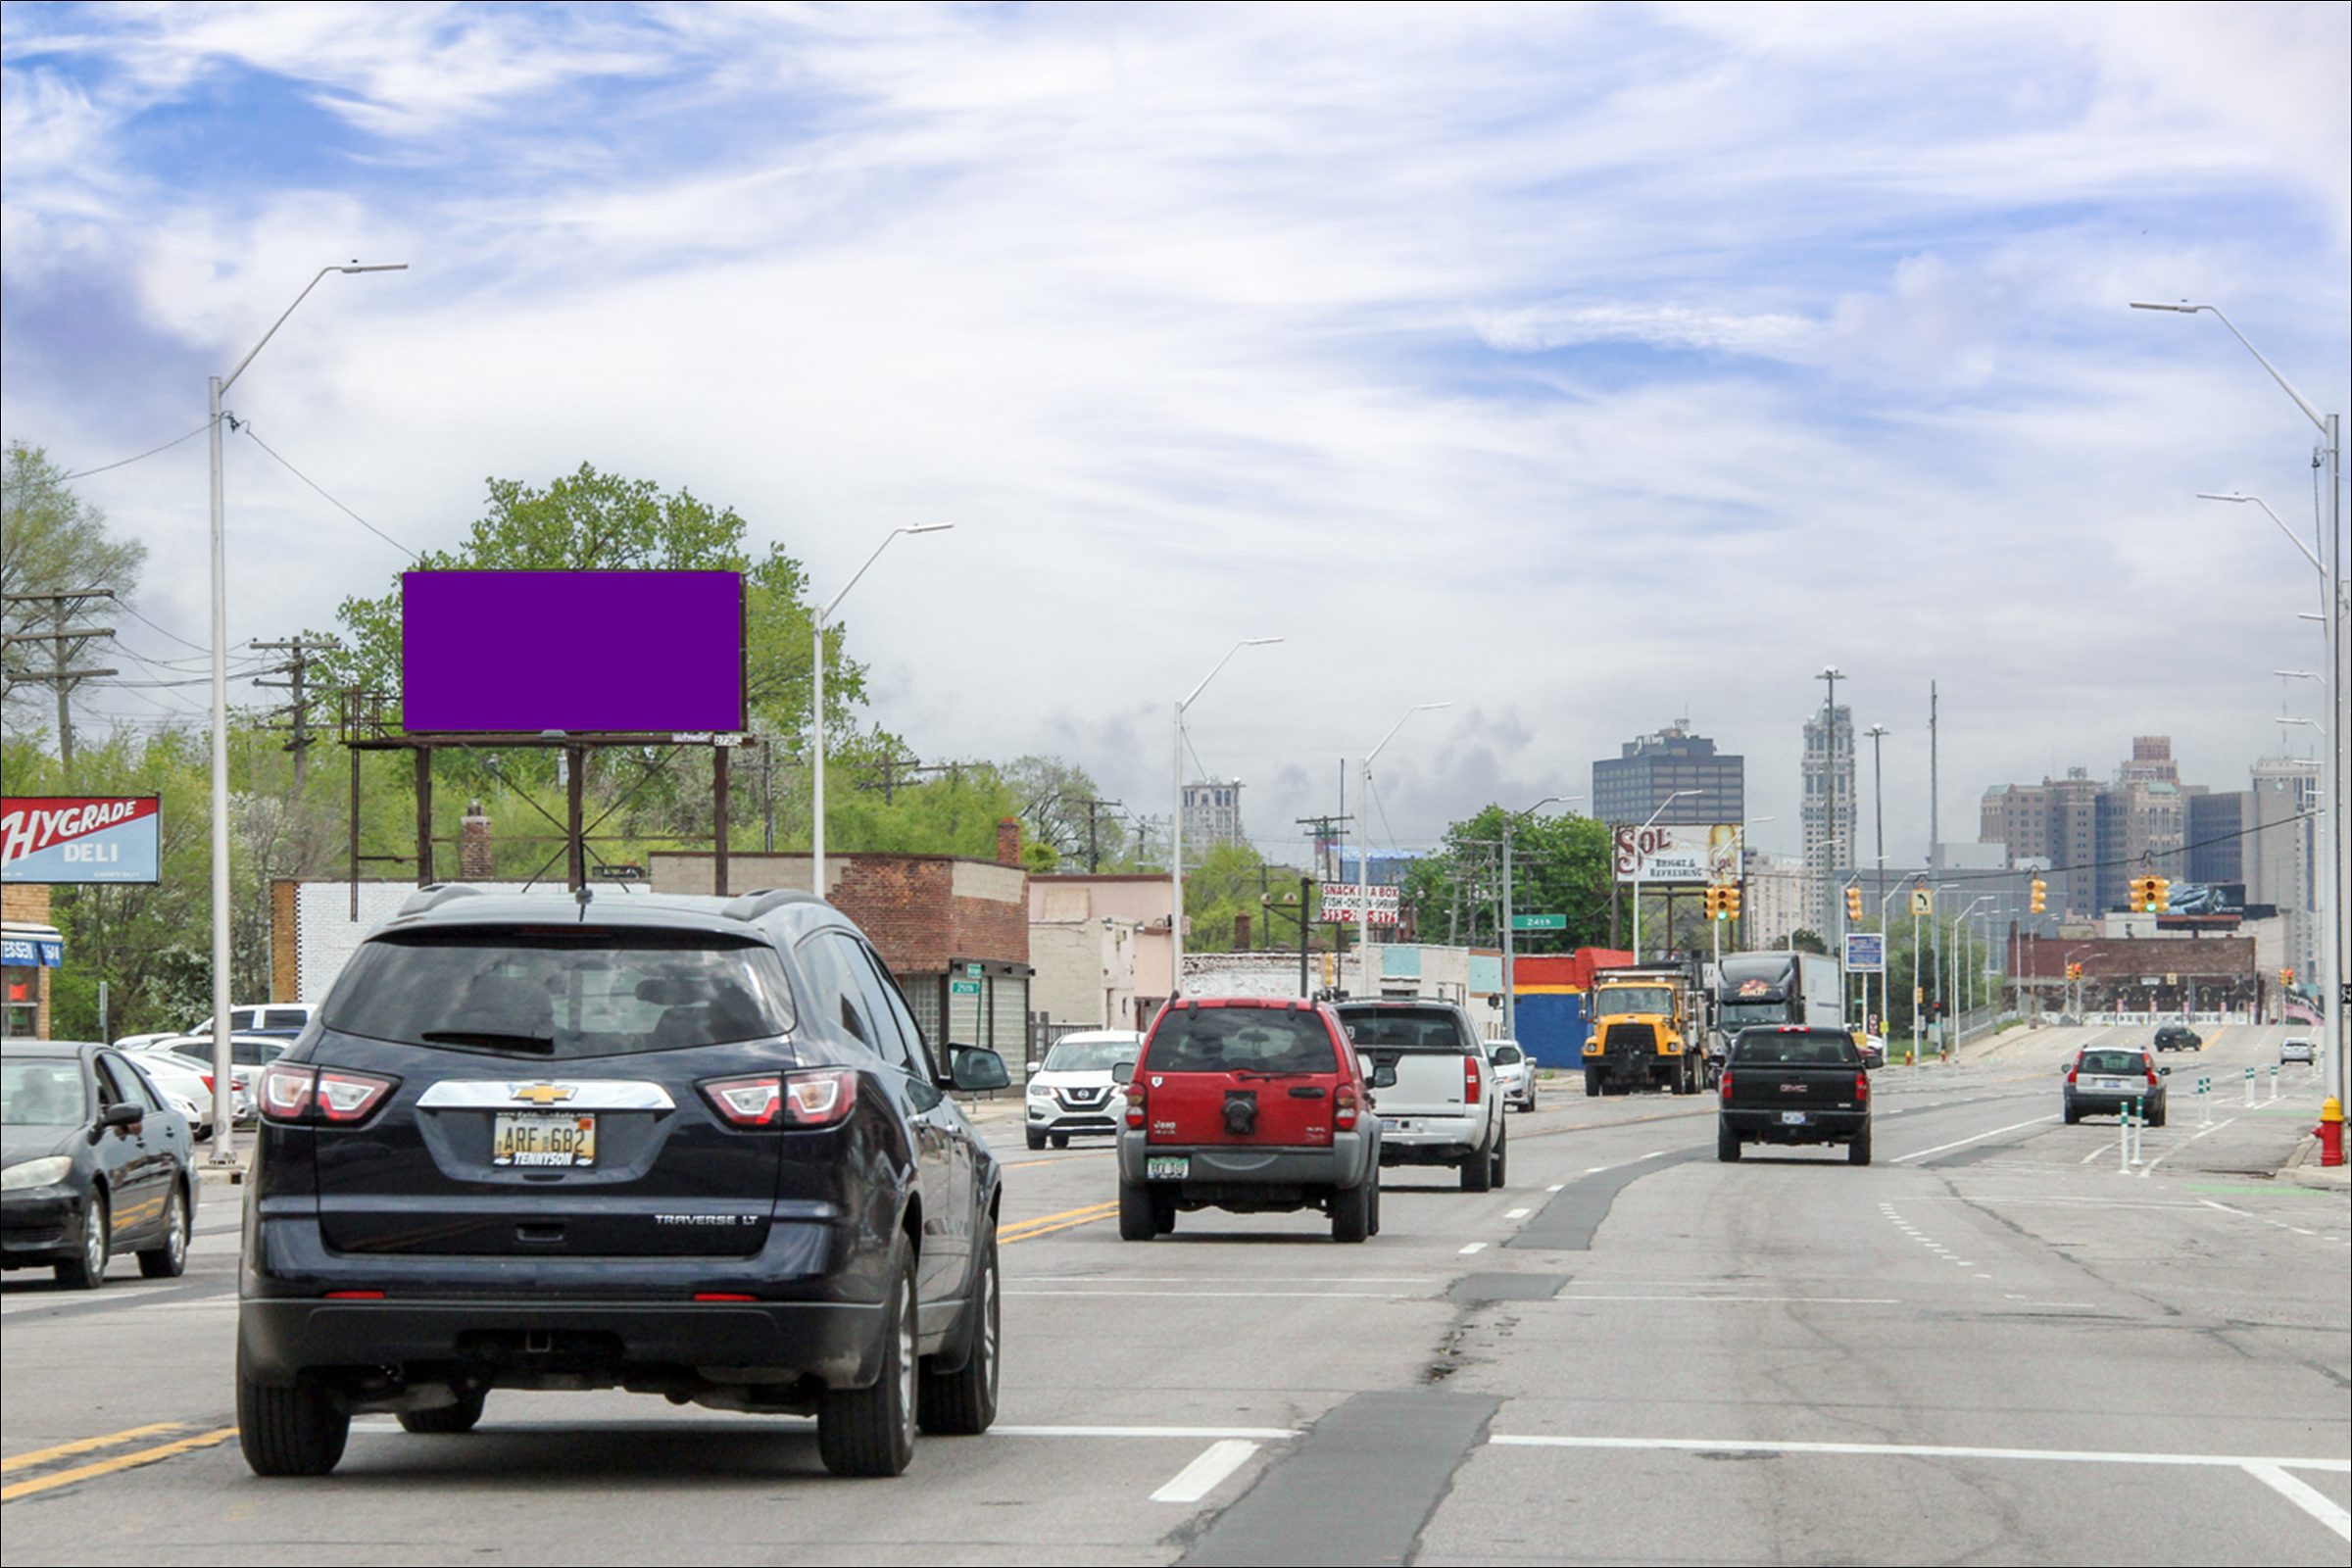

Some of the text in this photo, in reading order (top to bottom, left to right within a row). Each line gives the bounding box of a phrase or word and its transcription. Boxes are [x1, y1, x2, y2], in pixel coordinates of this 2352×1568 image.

[1, 800, 137, 869] HYGRADE
[64, 843, 119, 862] DELI
[1656, 858, 1686, 868] BRIGHT
[1650, 868, 1702, 877] REFRESHING
[1324, 886, 1355, 896] SNACK
[1370, 887, 1378, 897] A
[1379, 887, 1399, 898] BOX
[1323, 897, 1344, 907] FISH
[1153, 1120, 1176, 1129] Jeep
[504, 1127, 538, 1152] ARF
[551, 1128, 585, 1153] 682
[514, 1152, 573, 1166] TENNYSON
[655, 1215, 759, 1225] TRAVERSE LT
